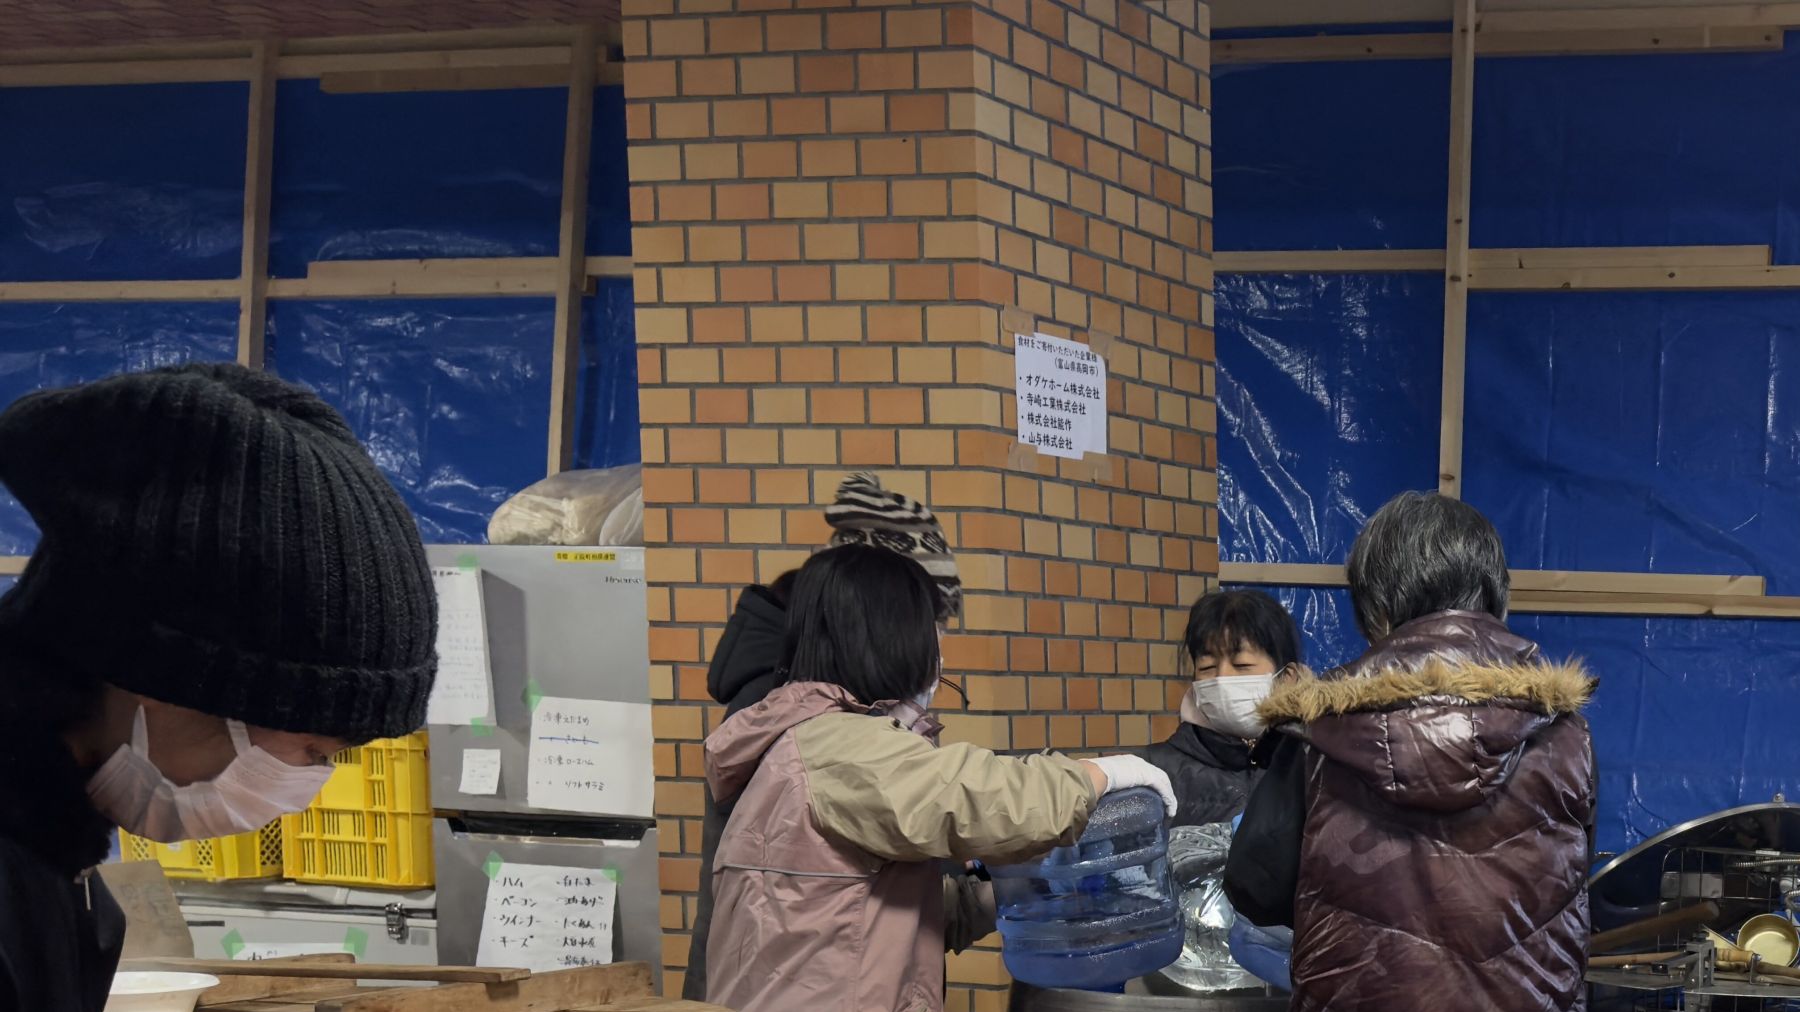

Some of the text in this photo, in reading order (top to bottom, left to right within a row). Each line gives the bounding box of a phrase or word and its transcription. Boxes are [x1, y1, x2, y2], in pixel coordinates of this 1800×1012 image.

[1026, 374, 1101, 400] オダケホーム株式会社
